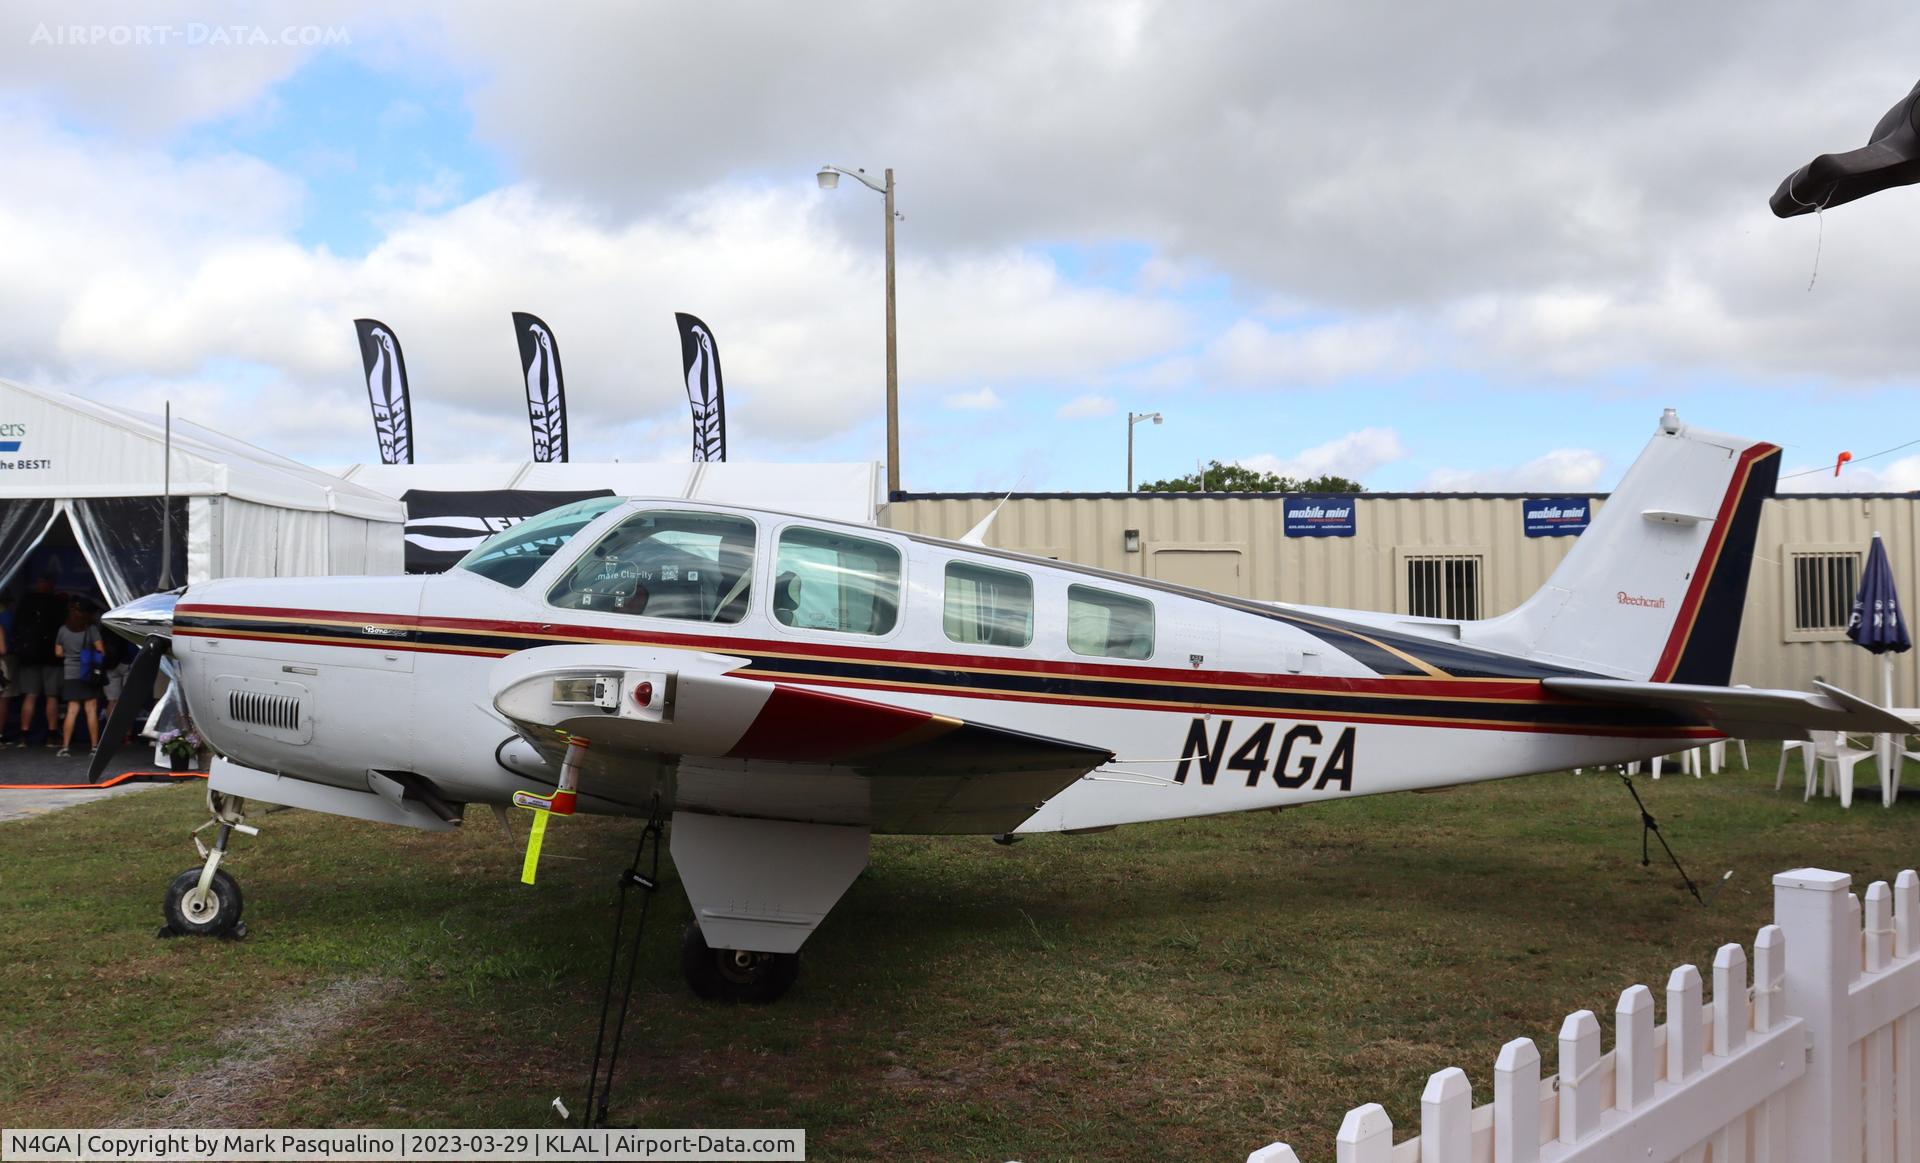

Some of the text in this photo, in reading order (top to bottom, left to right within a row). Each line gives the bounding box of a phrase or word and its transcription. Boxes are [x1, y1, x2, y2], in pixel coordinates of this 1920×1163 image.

[0, 424, 25, 437] ers
[373, 405, 395, 464] EYES
[391, 397, 408, 464] FLYIN
[530, 402, 550, 462] EYES
[548, 396, 562, 463] FLYIN
[705, 398, 722, 462] FLYIN
[0, 459, 51, 470] he BEST!
[1288, 506, 1351, 518] mobile mini
[1527, 506, 1586, 519] mobile mini
[1174, 718, 1356, 792] N4GA
